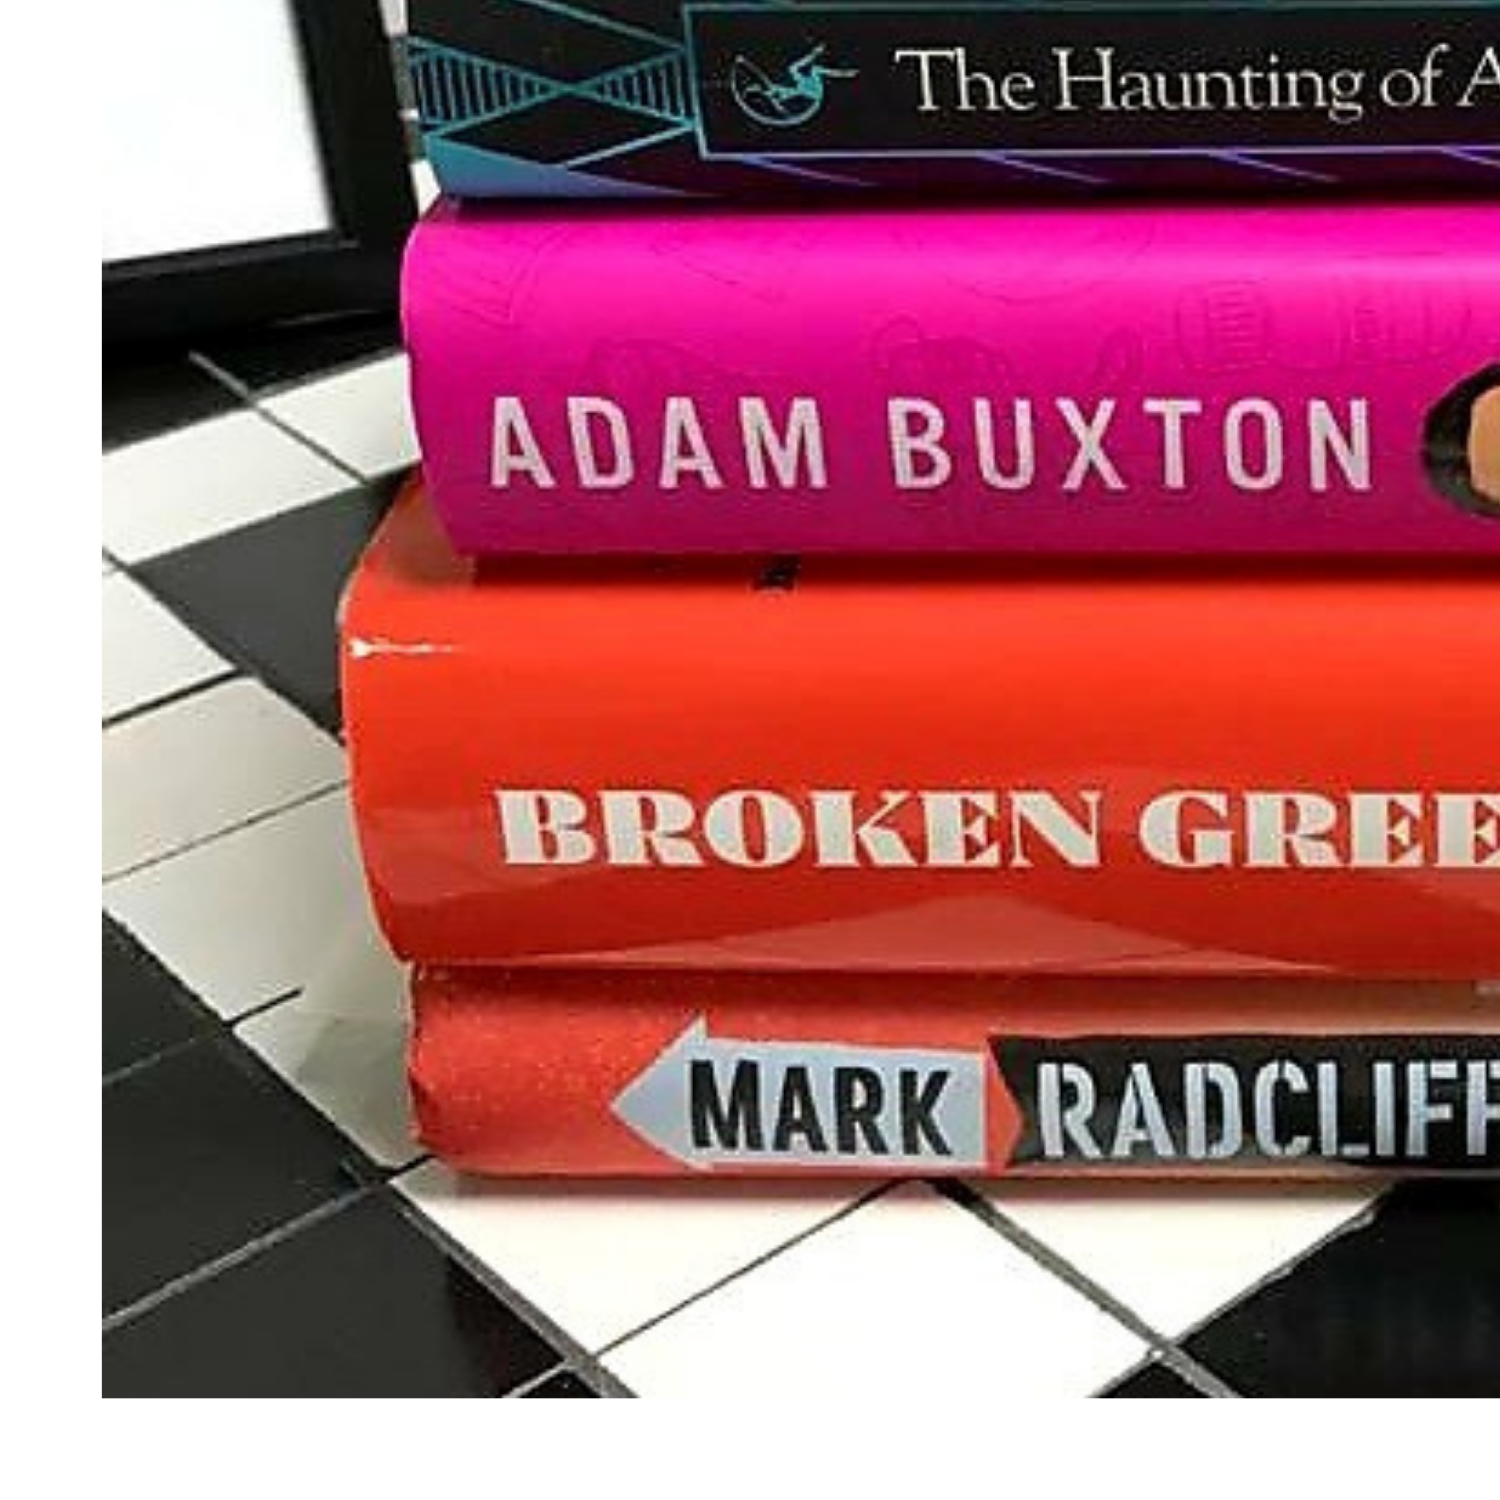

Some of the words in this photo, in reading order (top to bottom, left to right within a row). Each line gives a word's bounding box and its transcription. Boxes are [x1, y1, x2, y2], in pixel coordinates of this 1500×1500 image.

[895, 46, 1037, 113] The
[1052, 46, 1364, 124] Haunting
[1380, 41, 1453, 108] of
[489, 395, 831, 491] ADAM
[886, 395, 1374, 492] BUXTON
[493, 788, 1101, 869] BROKEN
[688, 1057, 954, 1158] MARK
